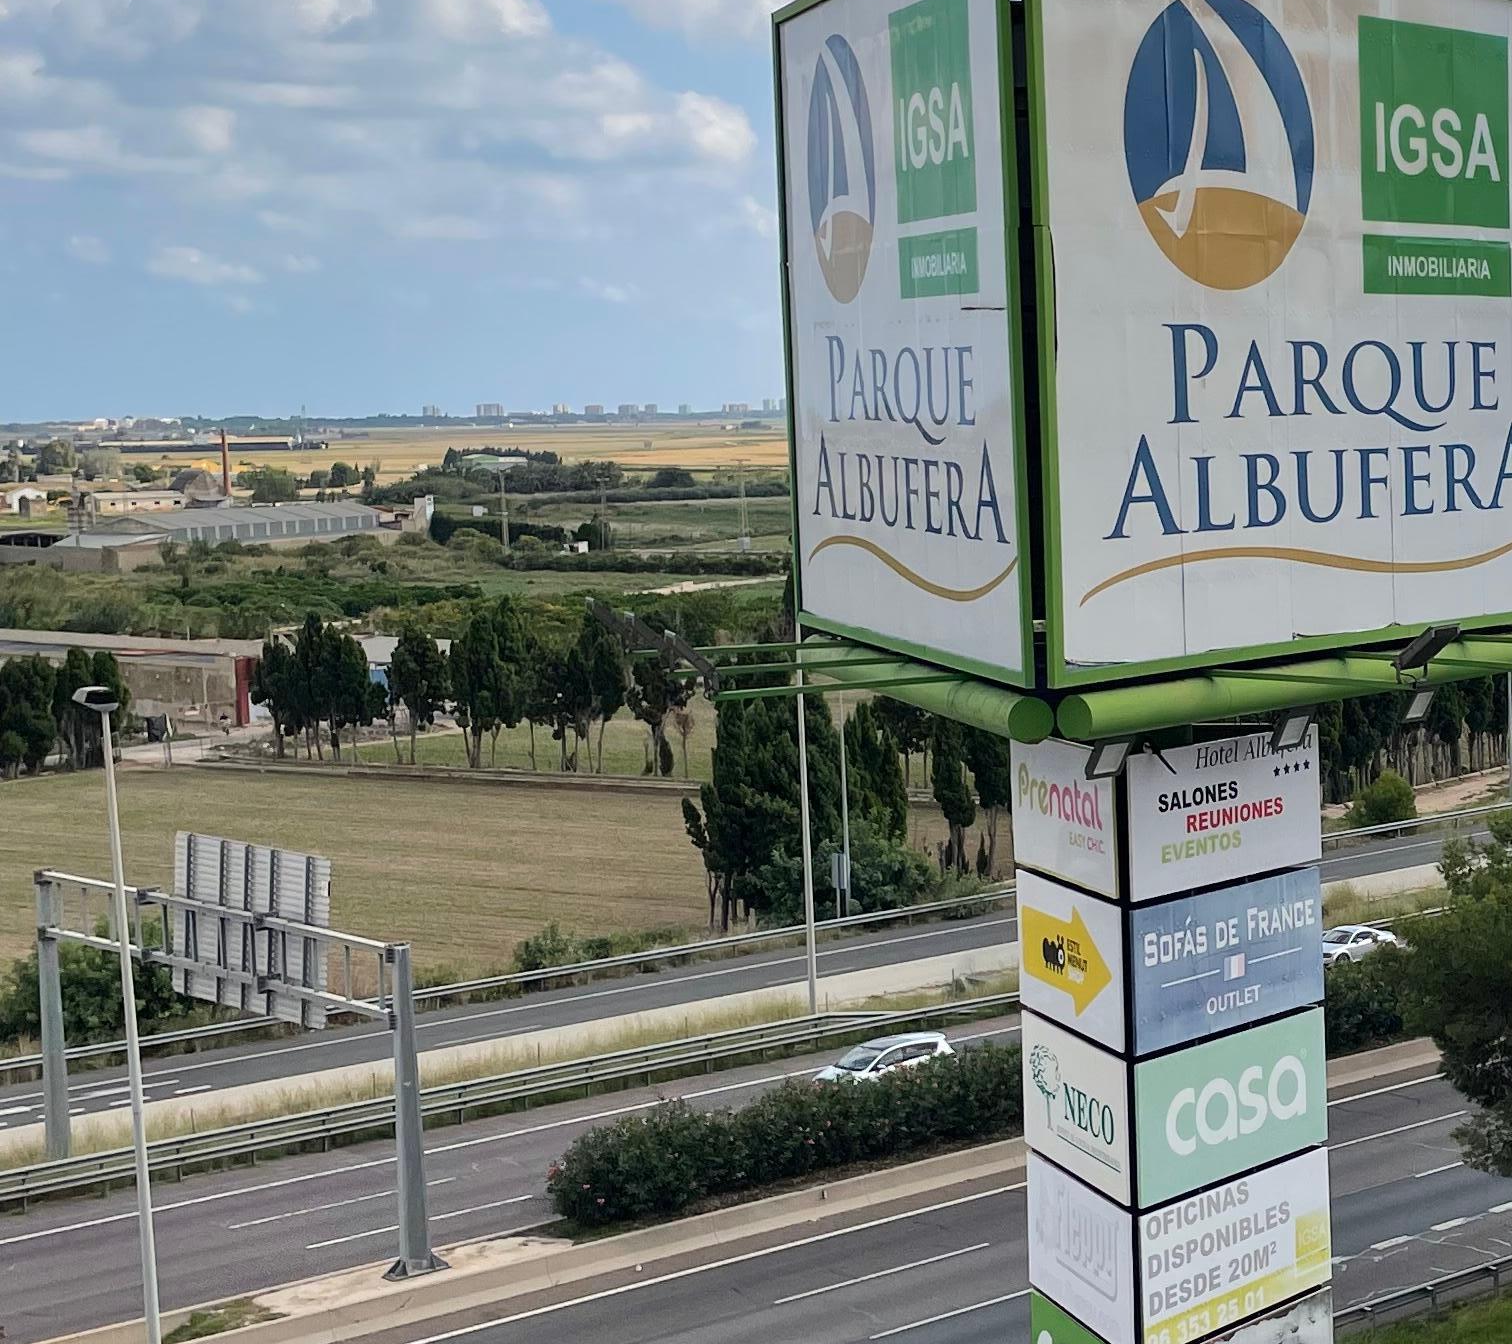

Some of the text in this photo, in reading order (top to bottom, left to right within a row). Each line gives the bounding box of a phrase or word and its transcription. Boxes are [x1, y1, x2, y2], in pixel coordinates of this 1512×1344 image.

[899, 81, 969, 172] IGSA
[1374, 101, 1501, 182] IGSA
[911, 251, 968, 280] INMOBILIARIA
[1387, 254, 1491, 281] INMOBILIARIA
[825, 335, 977, 445] PARQUE
[1162, 323, 1499, 432] PARQUE
[813, 430, 1011, 545] ALBUFERA
[1195, 740, 1238, 770] Hotel
[1158, 780, 1239, 813] SALONES
[1186, 797, 1284, 834] REUNIONES
[1161, 830, 1242, 864] EVENTOS
[1215, 918, 1240, 946] DE
[1247, 899, 1315, 942] FRANCE
[1206, 984, 1262, 1015] OUTLET
[1063, 1082, 1114, 1145] NECO
[1165, 1055, 1307, 1156] casa
[1146, 1180, 1250, 1241] OFICINAS
[1147, 1201, 1291, 1279] DISPONIBLES
[1149, 1263, 1221, 1317] DESDE
